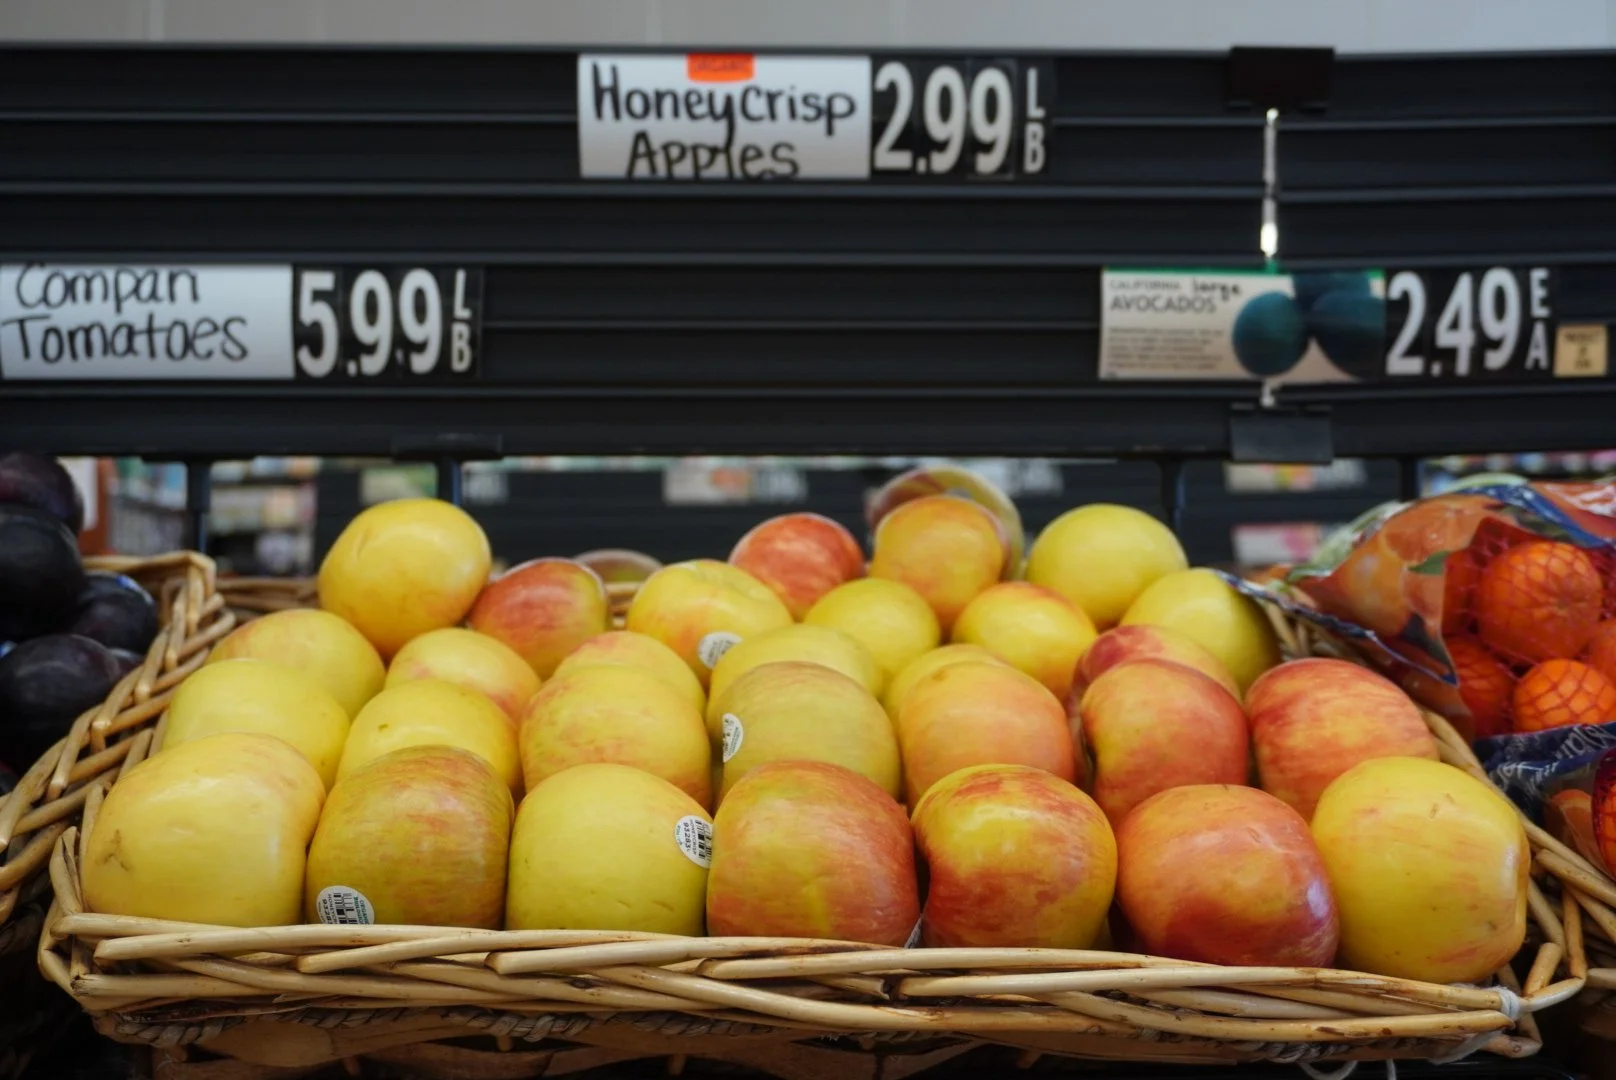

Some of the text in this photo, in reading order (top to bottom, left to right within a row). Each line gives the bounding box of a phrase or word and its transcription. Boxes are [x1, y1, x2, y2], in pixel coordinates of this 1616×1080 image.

[626, 130, 799, 178] Apples
[874, 61, 1013, 174] 2.99
[1, 312, 248, 364] Tomatoes
[297, 267, 442, 378] 5.99
[1111, 294, 1216, 314] AVOCADOS
[1386, 267, 1521, 376] 2.49
